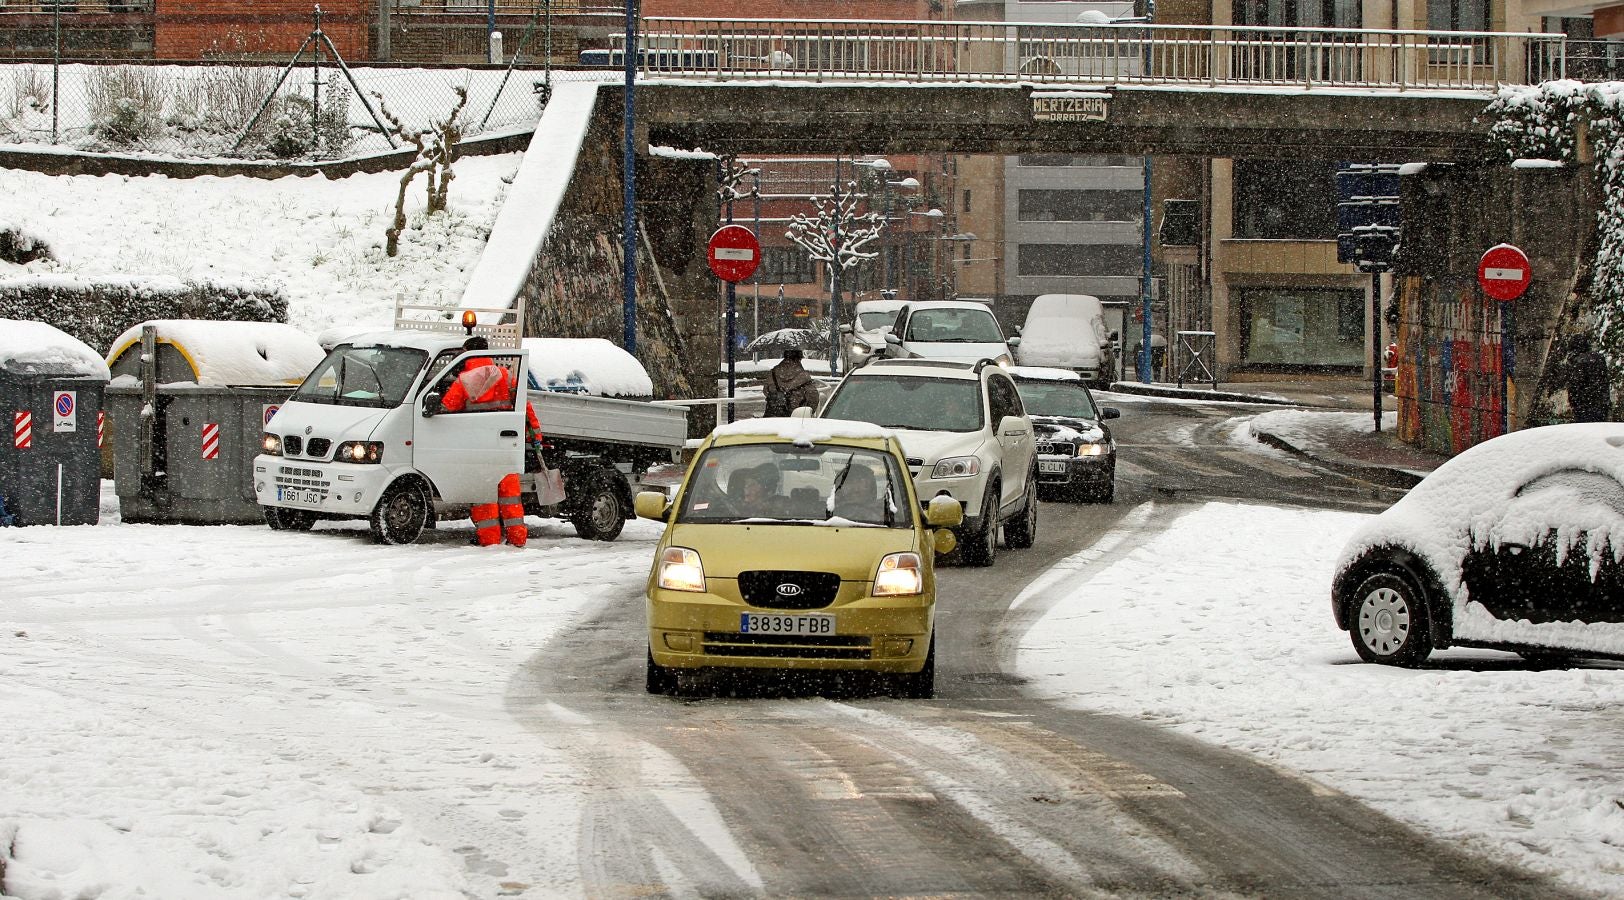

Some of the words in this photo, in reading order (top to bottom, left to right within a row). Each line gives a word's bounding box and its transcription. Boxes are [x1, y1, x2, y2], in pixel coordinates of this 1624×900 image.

[283, 490, 300, 501] 1661
[303, 492, 318, 504] JSC
[750, 616, 793, 632] 3839
[798, 617, 830, 633] FBB
